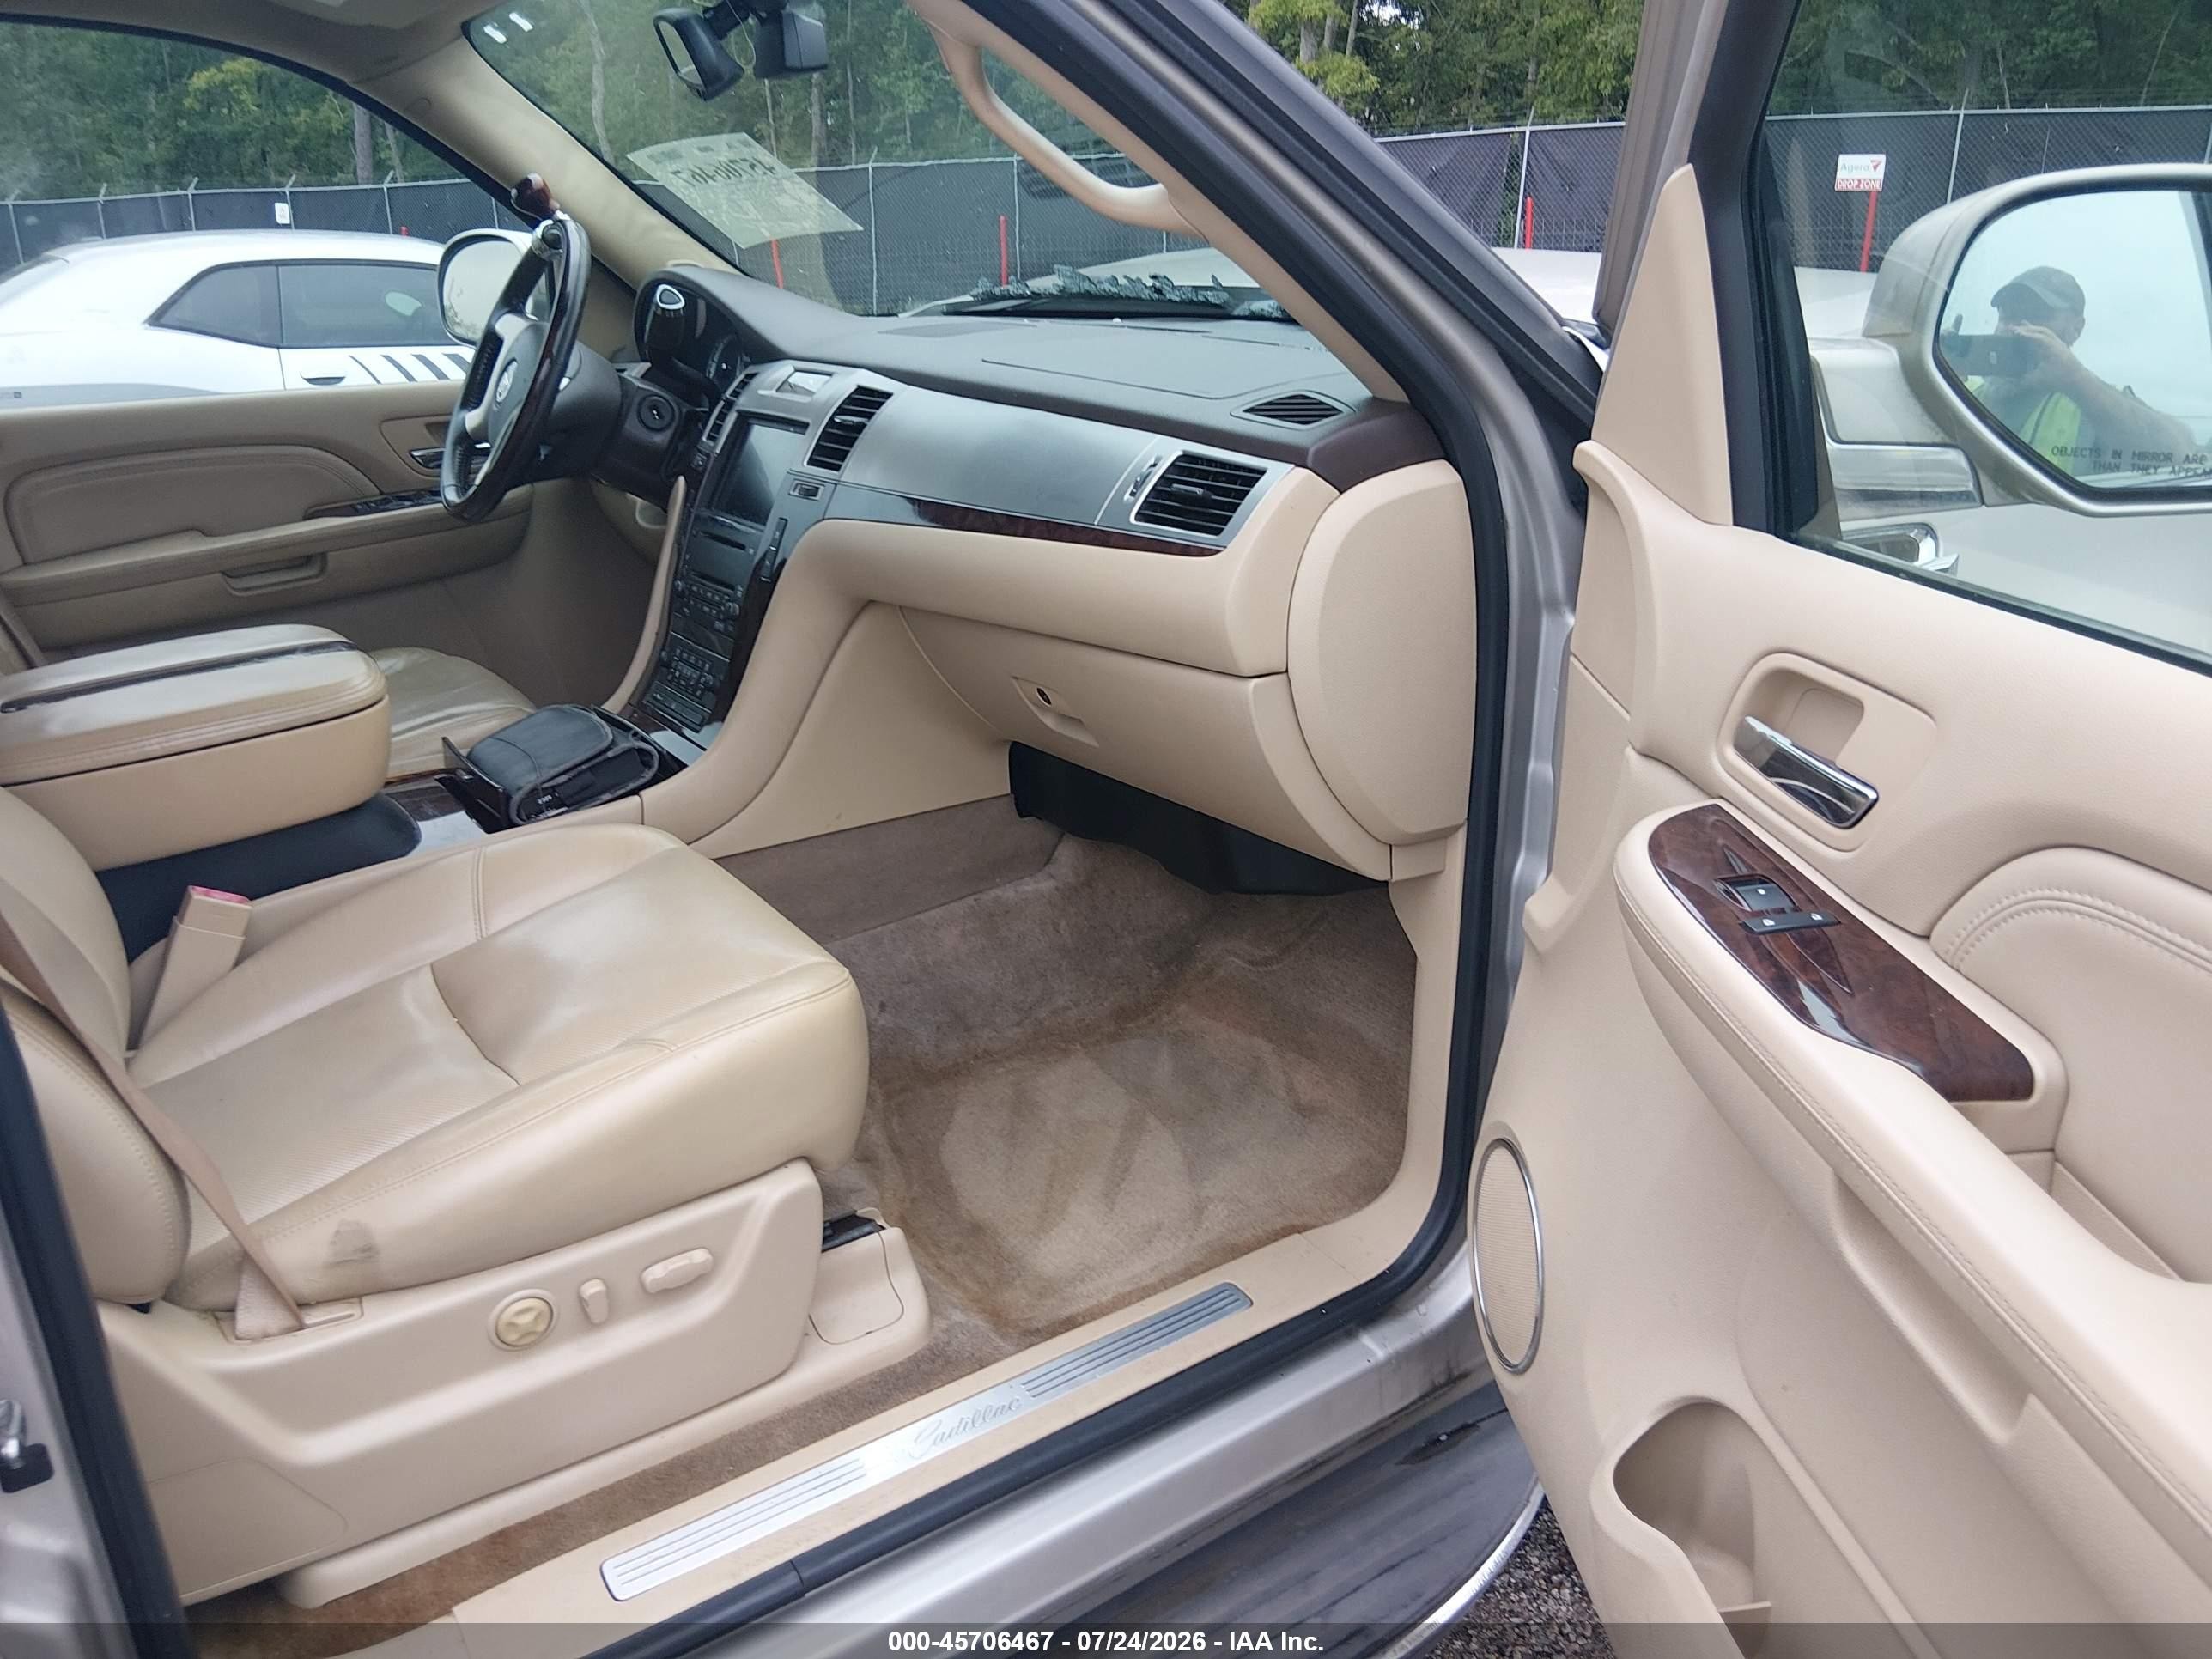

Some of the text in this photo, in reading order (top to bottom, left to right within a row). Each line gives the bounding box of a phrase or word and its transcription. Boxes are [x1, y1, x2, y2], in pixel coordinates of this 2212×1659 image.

[1840, 163, 1870, 174] Agero
[1837, 179, 1882, 190] DROP ZONE
[2051, 446, 2209, 465] OBJECTS IN MIRROR ARE
[2093, 460, 2122, 472] THAN
[2130, 463, 2158, 475] THEY
[908, 1398, 1022, 1459] Cadillac
